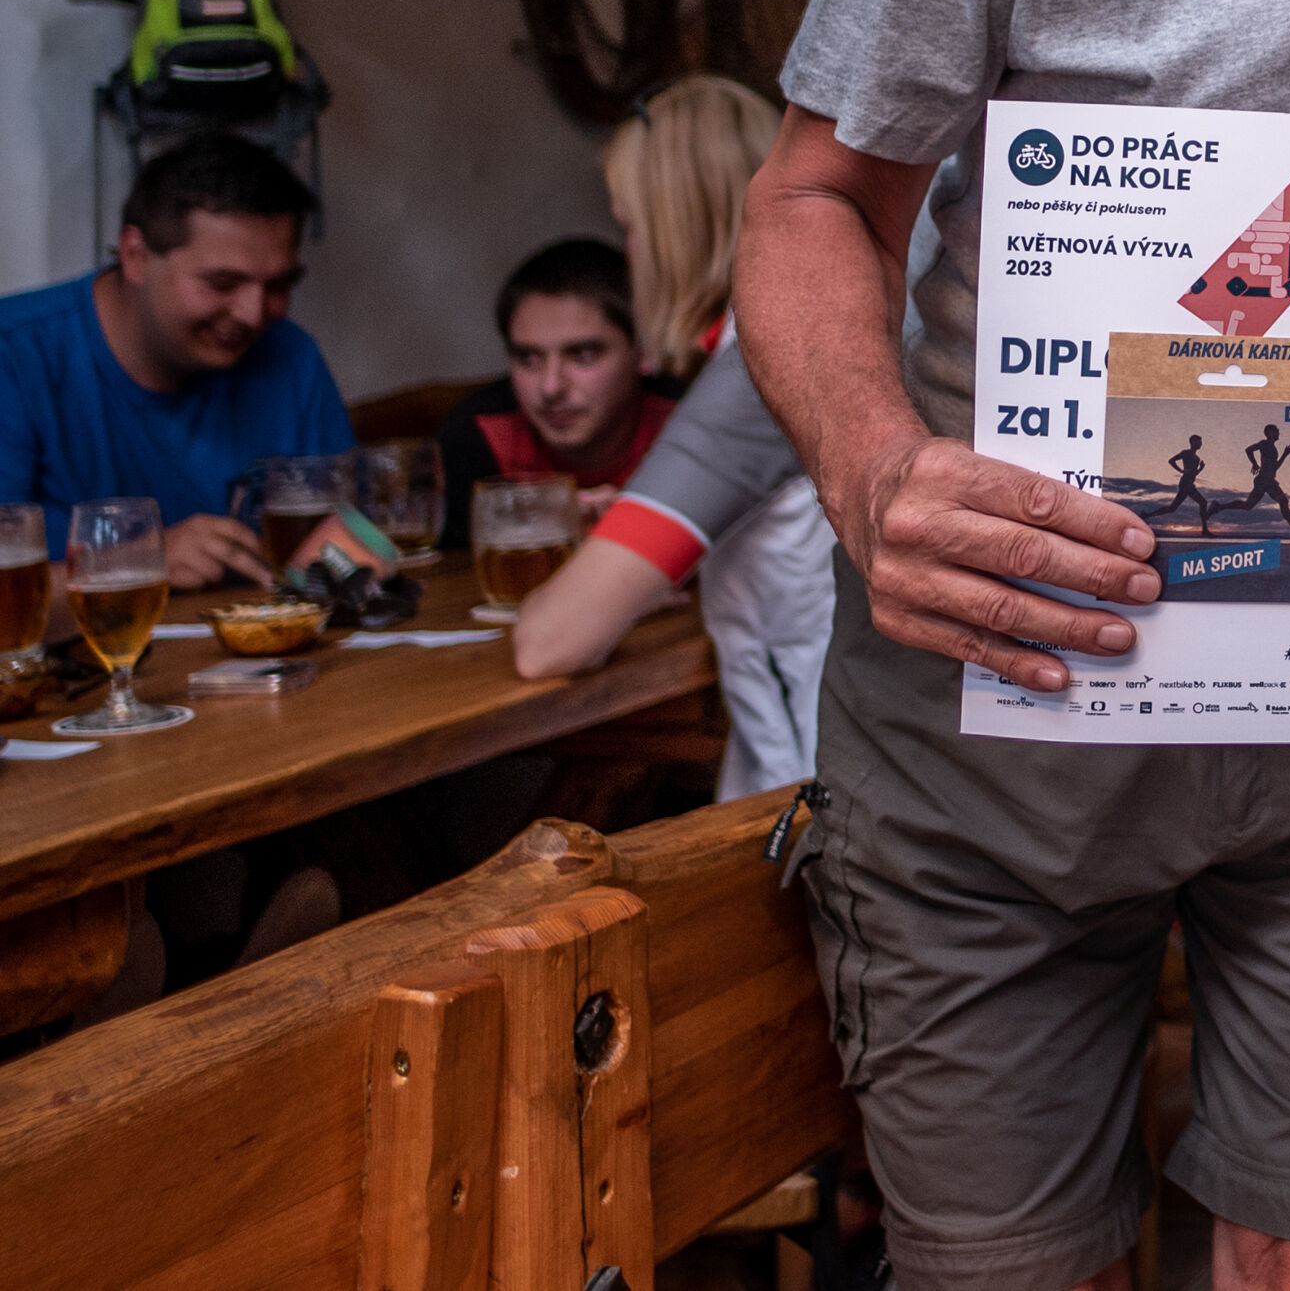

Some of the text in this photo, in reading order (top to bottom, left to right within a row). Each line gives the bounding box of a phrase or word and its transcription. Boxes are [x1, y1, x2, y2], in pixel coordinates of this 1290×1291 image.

[1072, 132, 1219, 162] DO PRÁCE
[1070, 164, 1192, 190] NA KOLE
[1007, 199, 1167, 216] nebo pěšky či poklusem
[1007, 233, 1193, 258] KVĚTNOVÁ VÝZVA
[1006, 259, 1052, 277] 2023
[1000, 336, 1110, 379] DIPL
[1168, 337, 1245, 359] DÁRKOVÁ
[997, 399, 1095, 439] za 1.
[1182, 549, 1265, 578] NA SPORT
